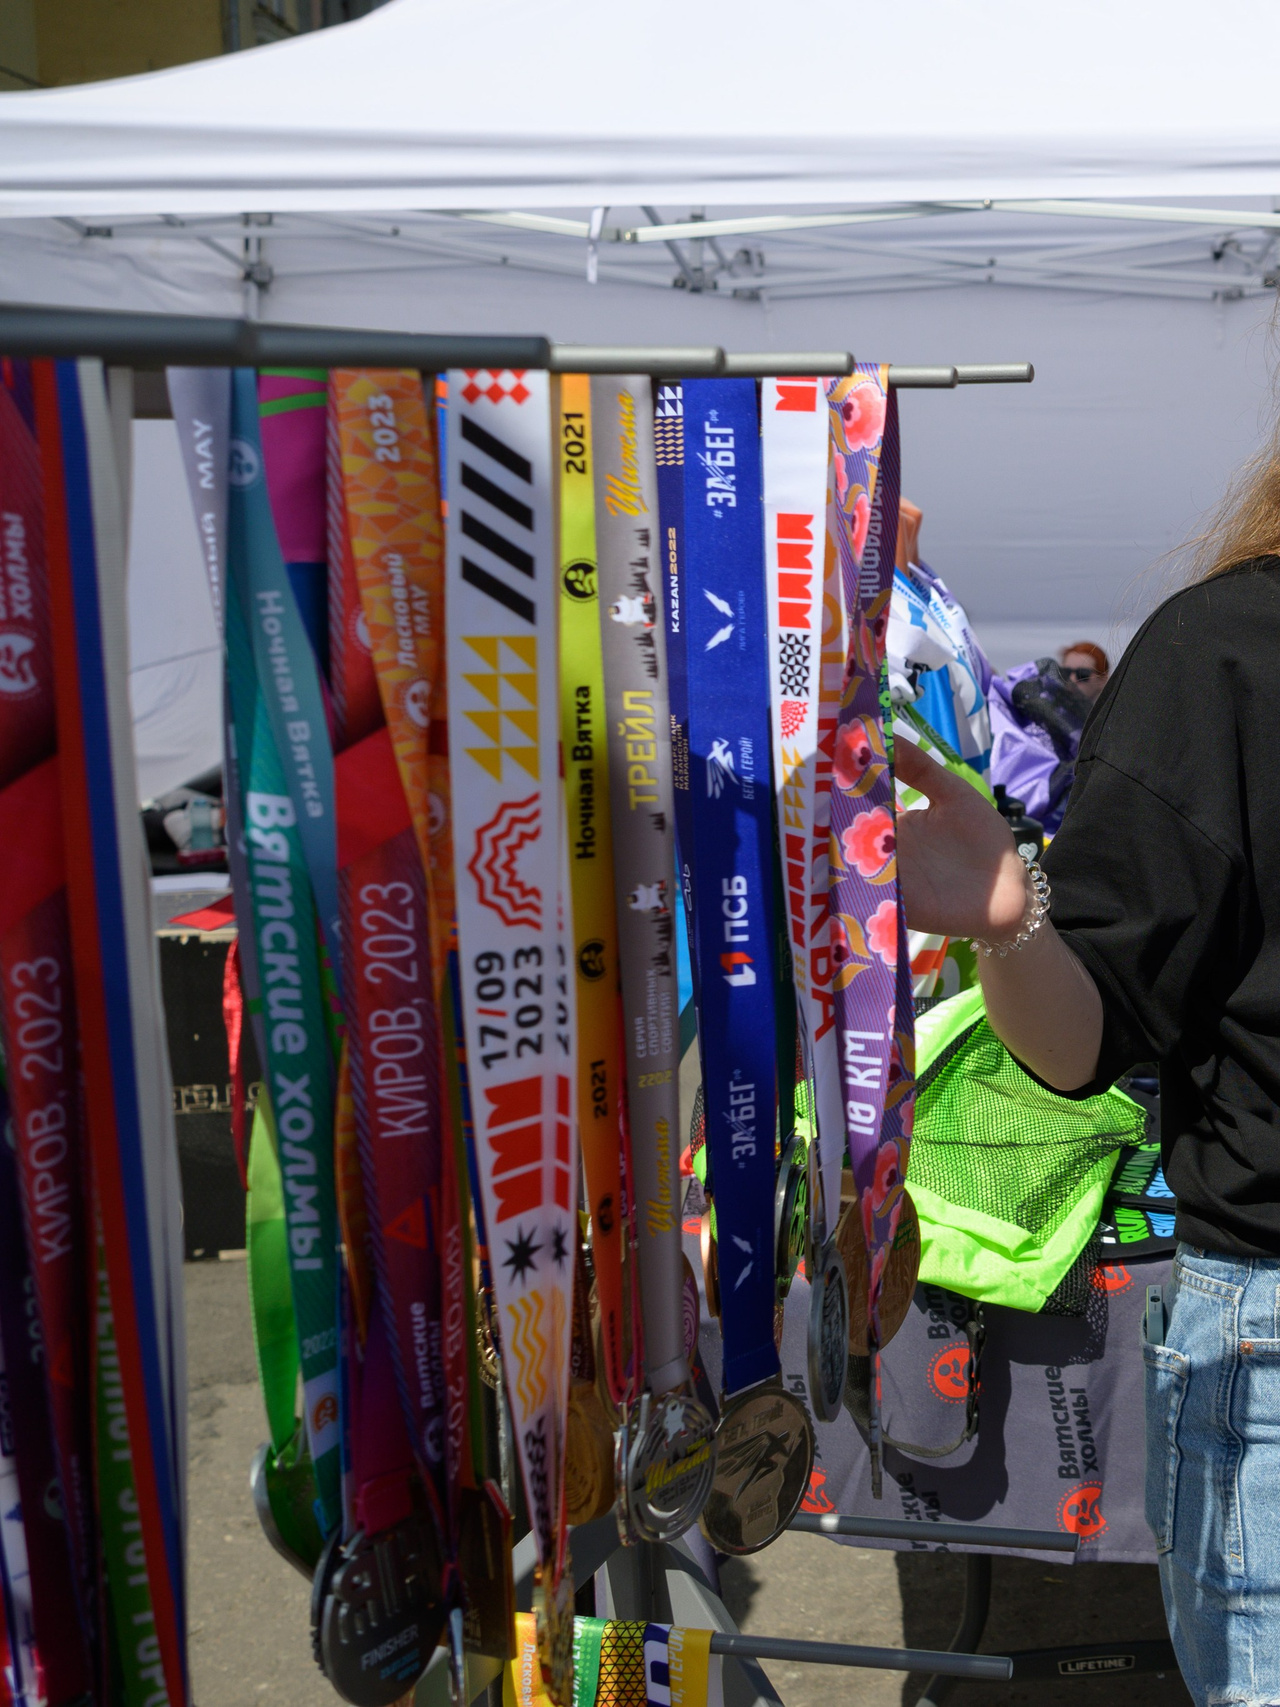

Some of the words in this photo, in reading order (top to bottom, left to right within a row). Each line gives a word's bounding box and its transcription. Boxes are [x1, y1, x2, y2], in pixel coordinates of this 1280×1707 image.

[368, 393, 402, 464] 2023
[563, 411, 587, 475] 2021
[257, 589, 299, 713] Ночная
[286, 720, 325, 818] Вятка
[572, 684, 592, 762] Вятка
[621, 689, 657, 811] ТРЕЙЛ
[574, 764, 596, 861] Ночная
[246, 790, 307, 1056] Вятские
[360, 880, 420, 982] 2023
[724, 874, 747, 943] ПСБ
[12, 955, 62, 1078] 2023
[475, 948, 509, 1071] 17/09
[515, 943, 545, 1060] 2023
[592, 1058, 608, 1120] 2021
[846, 1100, 877, 1137] 10
[276, 1072, 323, 1271] холмы
[1045, 1366, 1081, 1480] Вятские
[1070, 1387, 1100, 1474] холмы
[359, 1624, 419, 1672] FINISHER
[521, 1641, 537, 1707] Ласковы
[1067, 1658, 1126, 1672] LIFETIME
